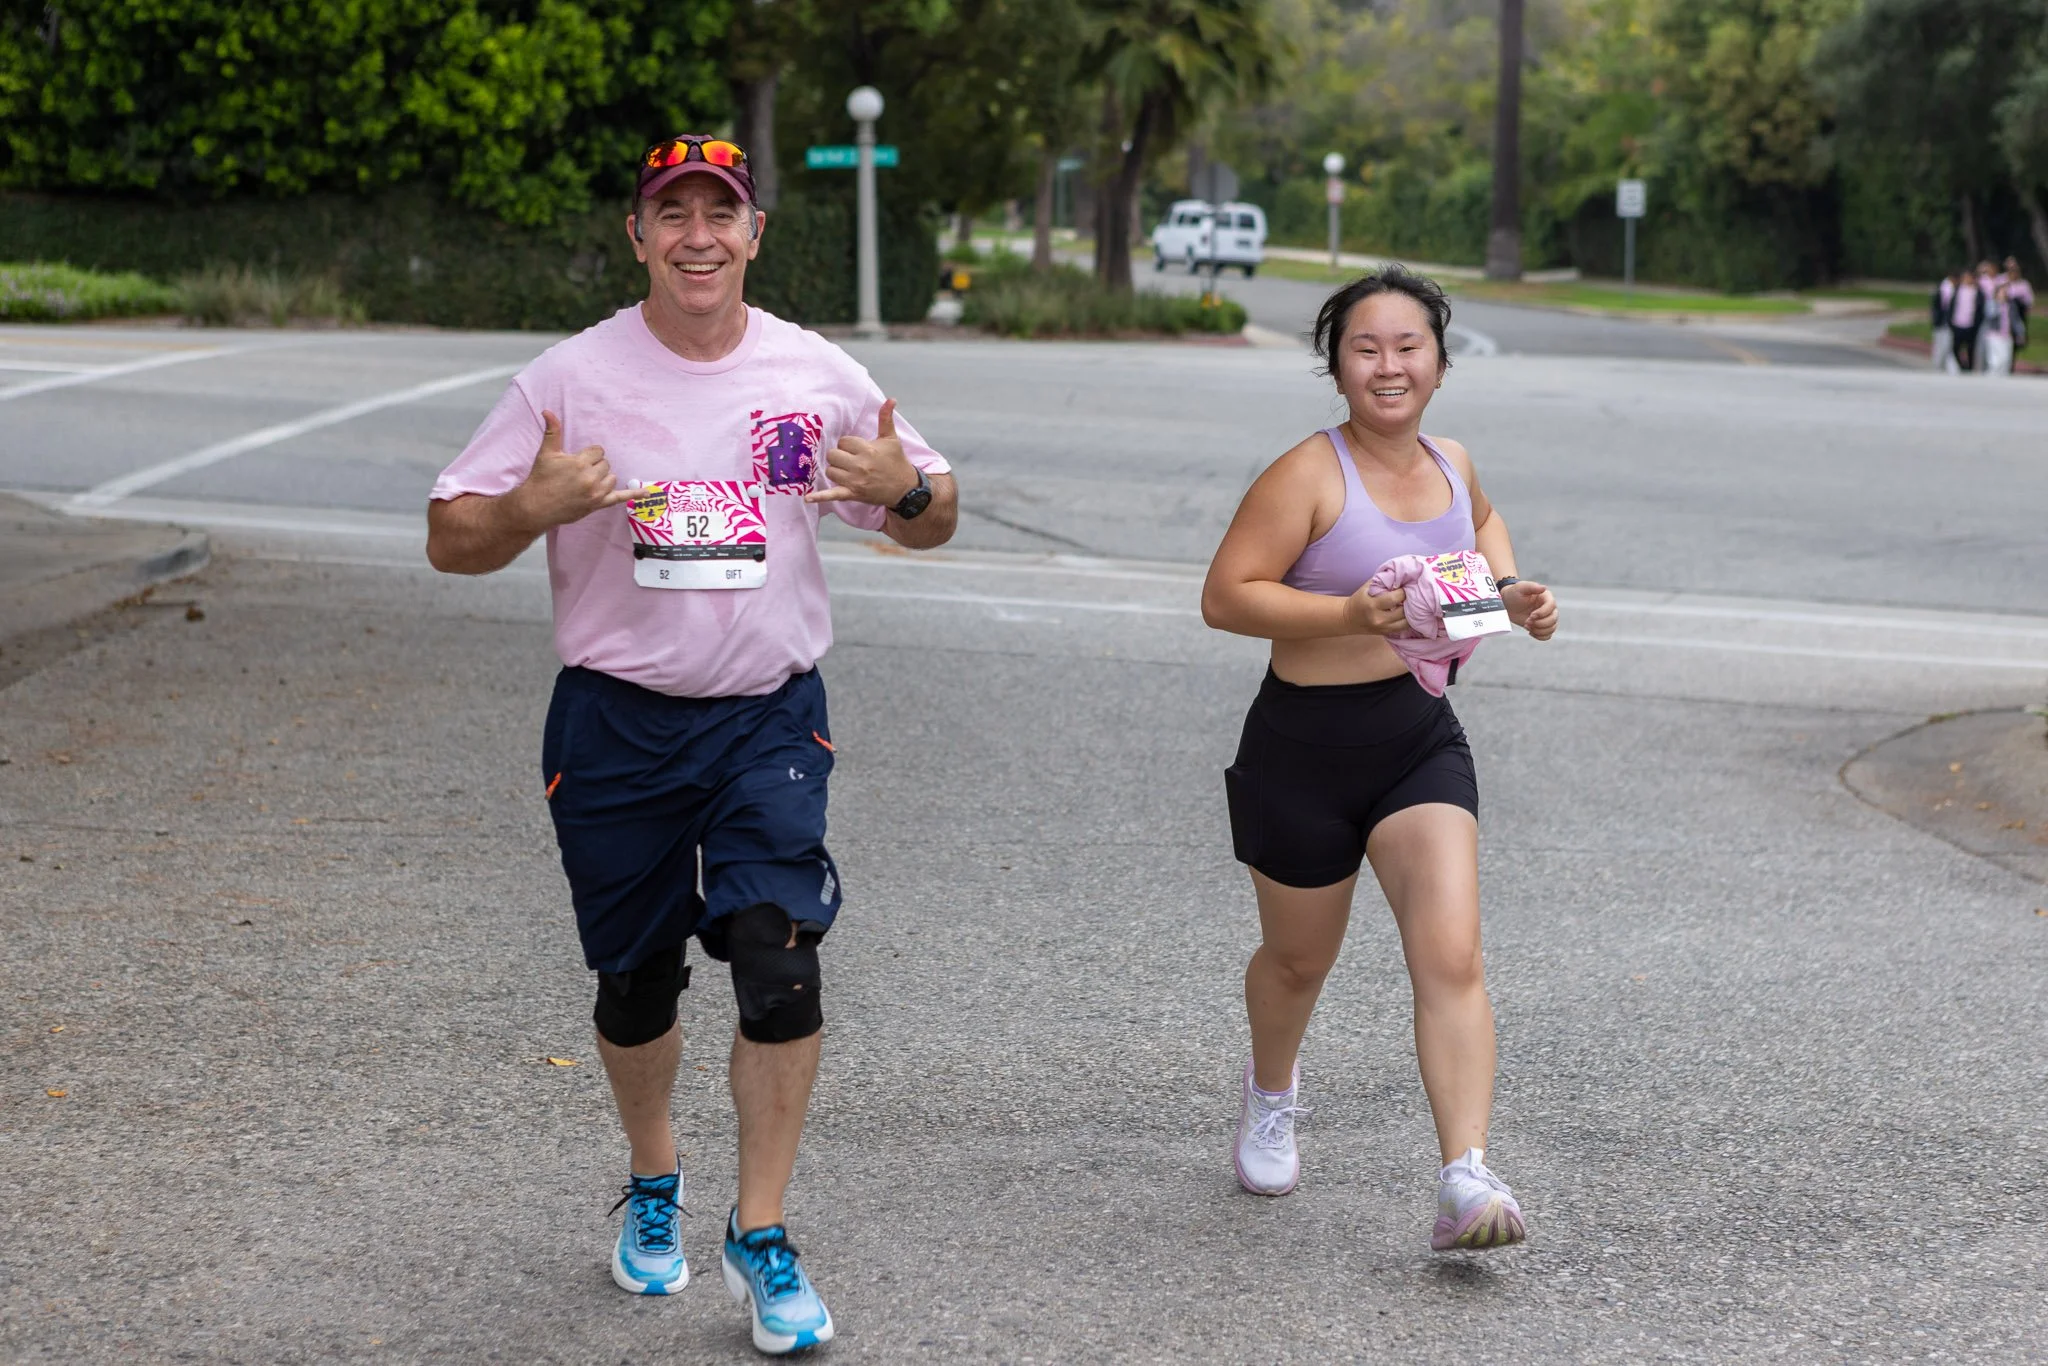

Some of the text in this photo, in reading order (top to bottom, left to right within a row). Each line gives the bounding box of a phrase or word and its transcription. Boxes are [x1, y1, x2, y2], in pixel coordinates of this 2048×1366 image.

[686, 515, 710, 538] 52
[659, 569, 742, 580] 52 GIFT
[1485, 576, 1497, 593] 9
[1473, 619, 1484, 627] 96
